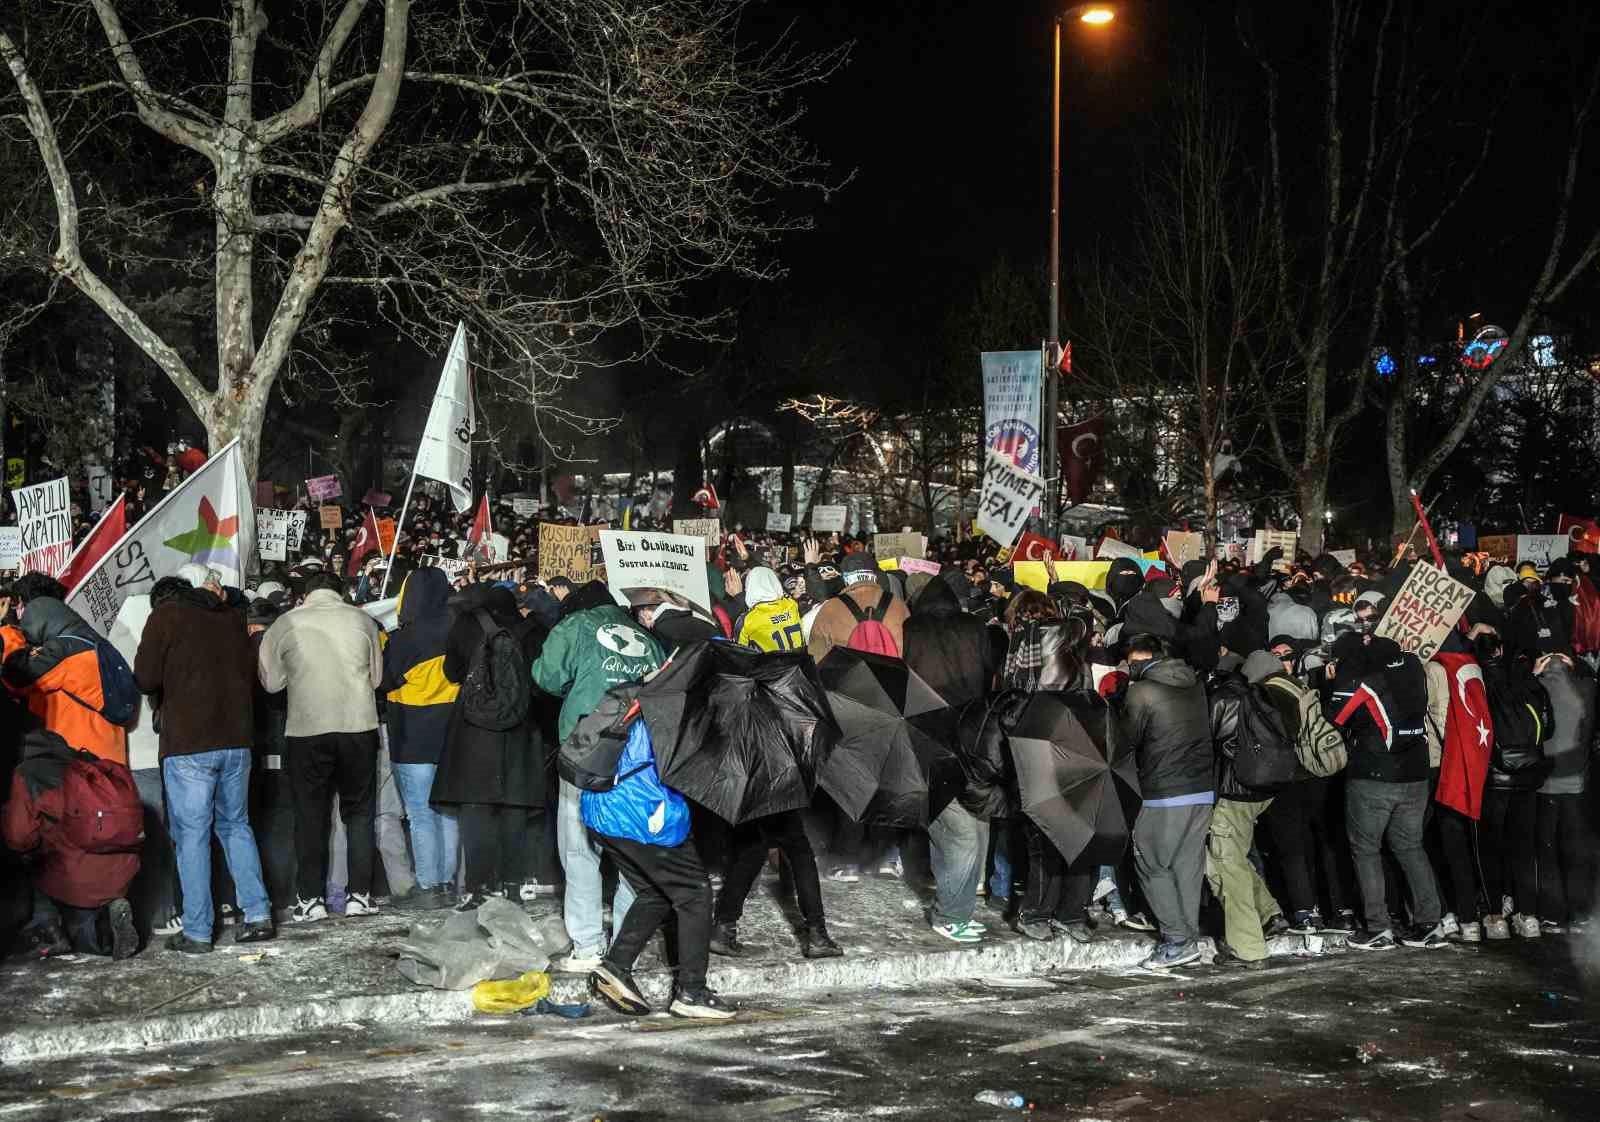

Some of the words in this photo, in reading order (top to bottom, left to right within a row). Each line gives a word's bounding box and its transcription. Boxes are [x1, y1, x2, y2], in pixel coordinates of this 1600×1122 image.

[21, 512, 70, 552] KAPATIN
[1406, 580, 1453, 613] RECEP
[1413, 563, 1473, 609] HOCAM
